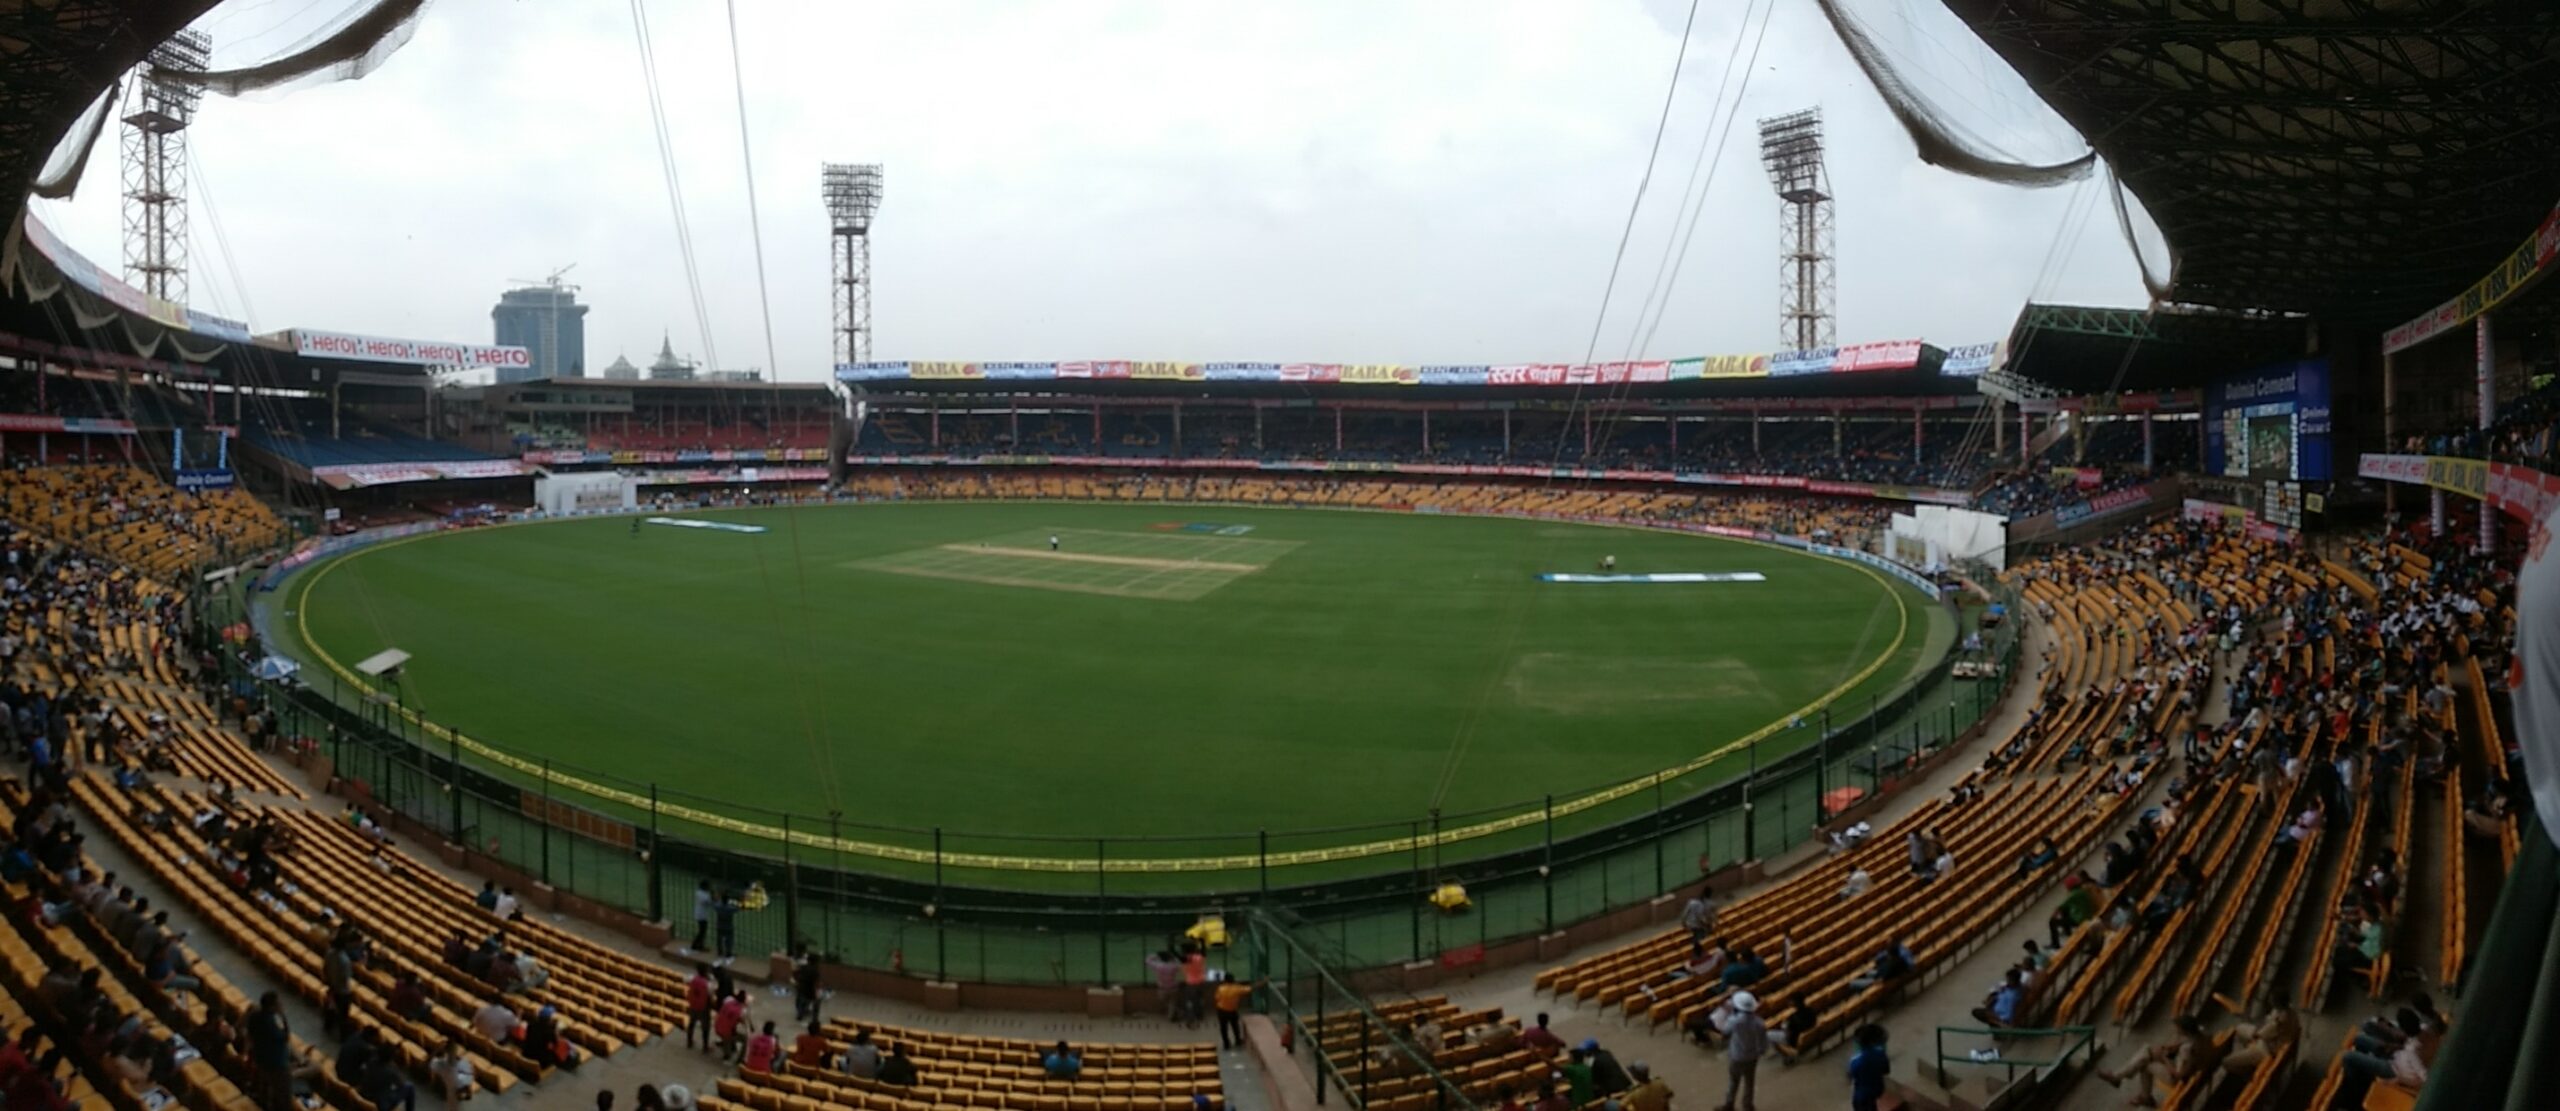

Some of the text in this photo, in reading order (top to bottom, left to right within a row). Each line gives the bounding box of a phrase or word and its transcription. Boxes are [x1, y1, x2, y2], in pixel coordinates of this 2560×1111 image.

[475, 348, 528, 364] Hero
[1952, 343, 1994, 359] KENT
[2257, 372, 2296, 396] Cement
